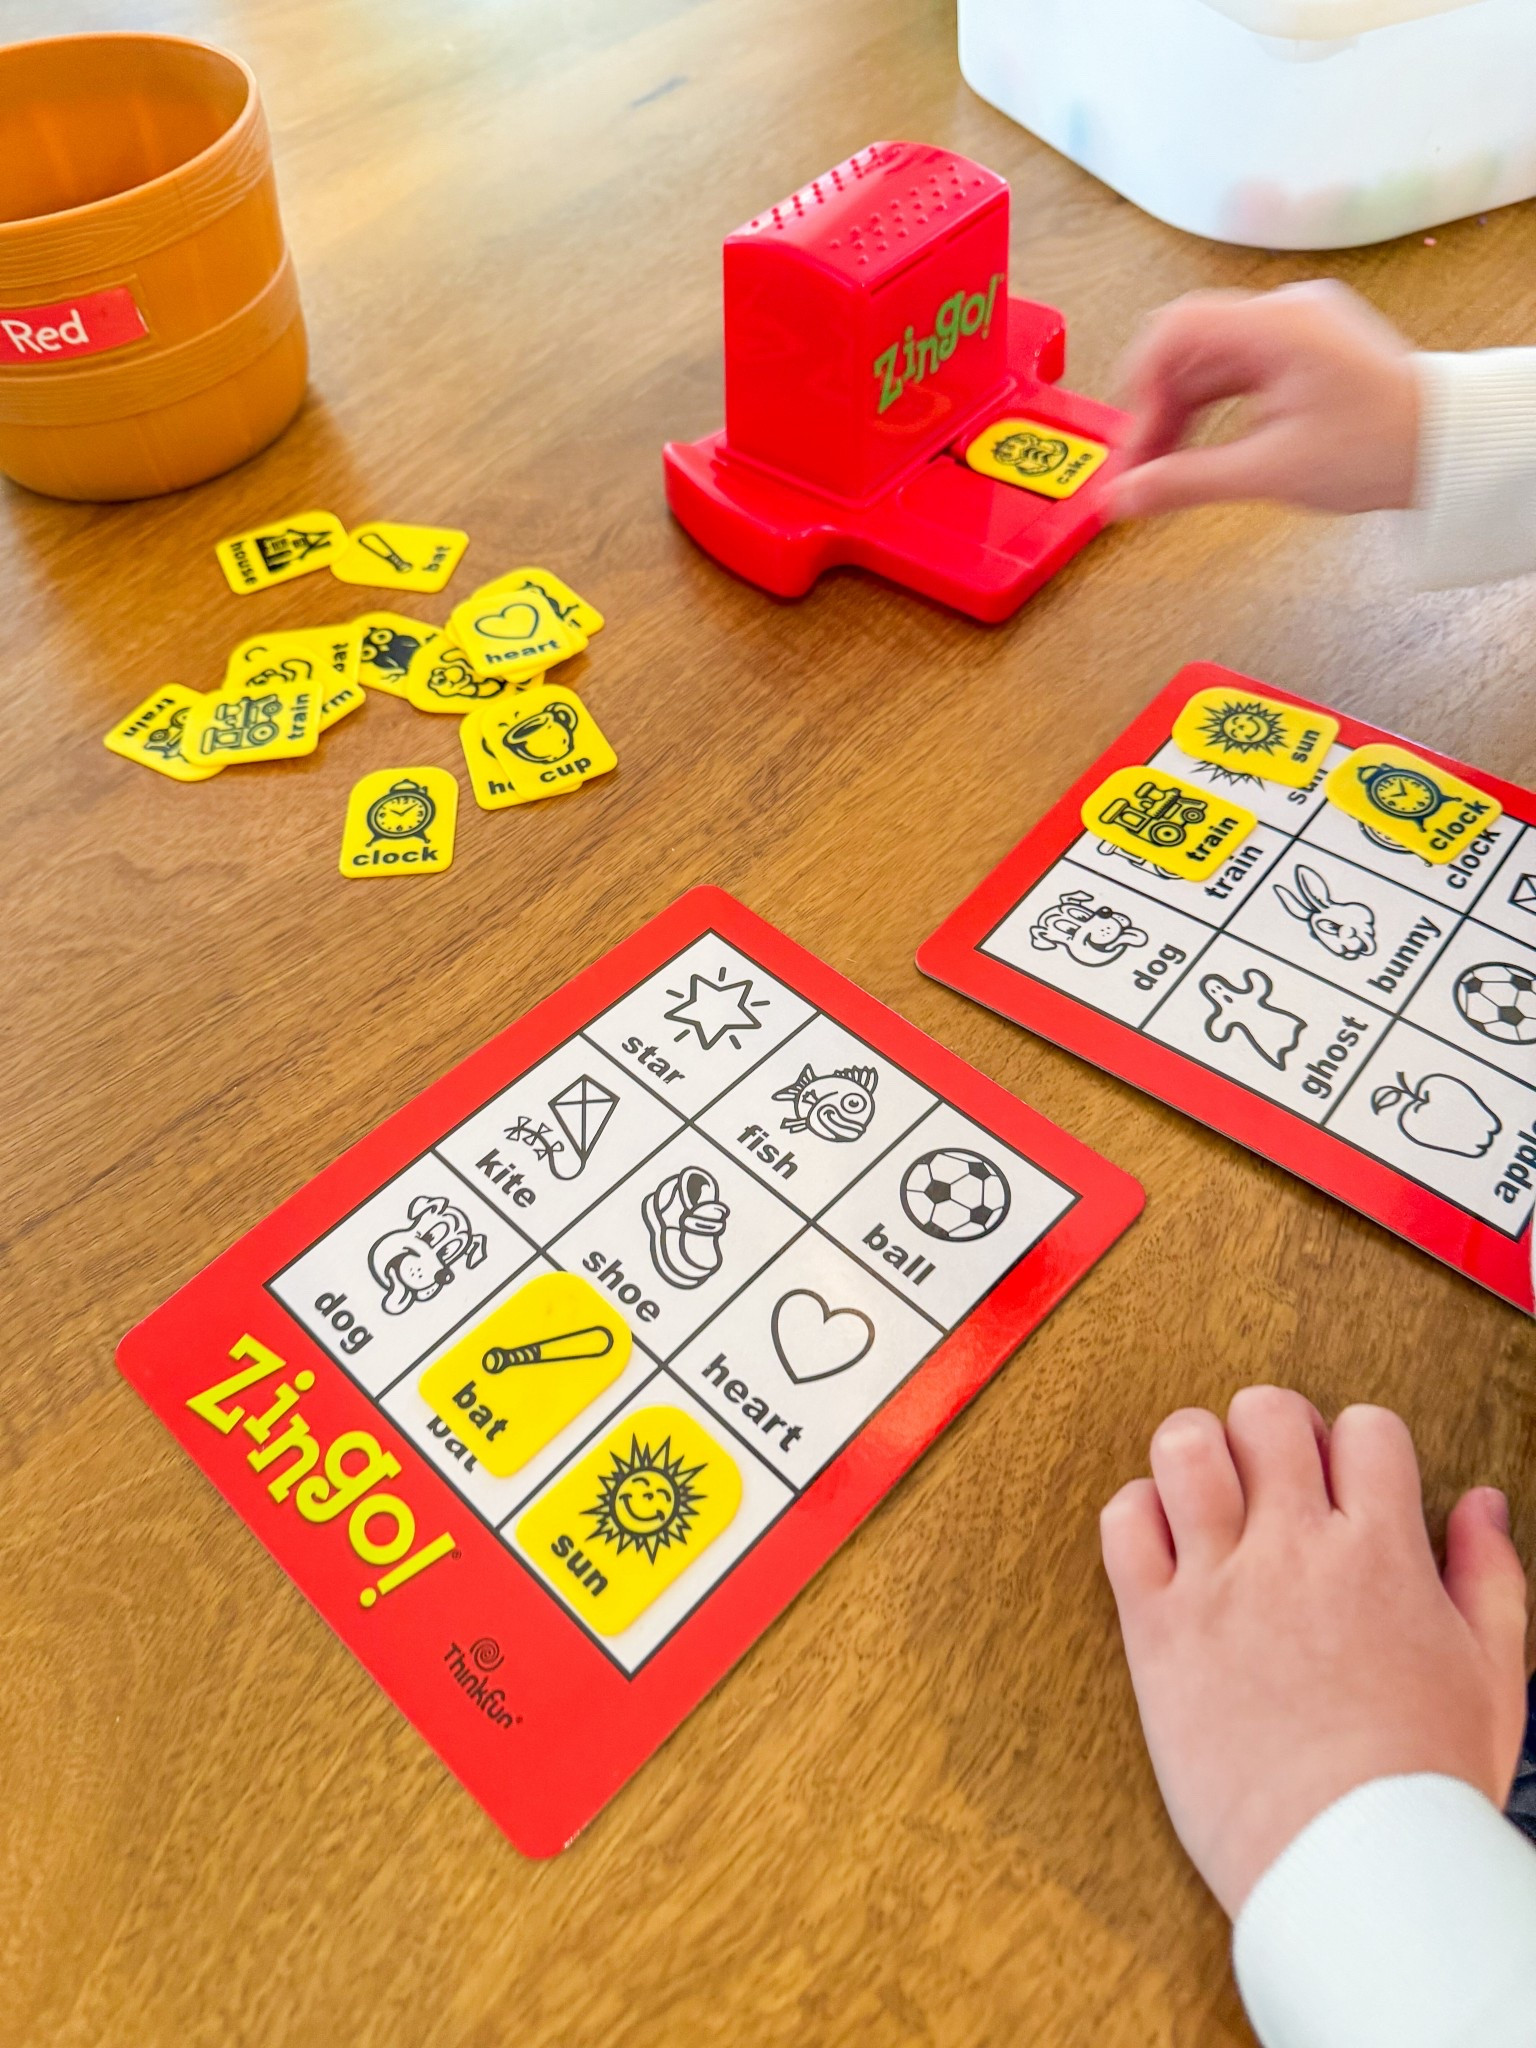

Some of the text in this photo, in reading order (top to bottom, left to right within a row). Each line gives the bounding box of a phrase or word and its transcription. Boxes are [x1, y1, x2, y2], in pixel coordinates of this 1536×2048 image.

[1, 309, 89, 353] Red
[873, 273, 1002, 414] Zingo!
[1056, 453, 1093, 484] cake
[230, 540, 258, 585] house
[422, 545, 451, 572] bat
[485, 640, 560, 663] heart
[122, 698, 175, 738] train
[287, 693, 310, 741] train
[540, 758, 592, 783] cup
[1290, 728, 1320, 763] sun
[1186, 815, 1239, 862] train
[1429, 801, 1491, 851] clock
[352, 846, 439, 866] clock
[1204, 846, 1264, 899] train
[1446, 829, 1501, 889] clock
[1133, 943, 1187, 992] dog
[1367, 915, 1442, 994] bunny
[621, 1036, 686, 1085] star
[1300, 1015, 1369, 1099] ghost
[736, 1124, 800, 1180] fish
[474, 1148, 537, 1209] kite
[861, 1223, 936, 1287] ball
[582, 1250, 661, 1322] shoe
[314, 1291, 375, 1354] dog
[452, 1380, 509, 1442] bat
[701, 1353, 804, 1453] heart
[185, 1333, 456, 1608] Zingo!
[551, 1533, 608, 1598] sun
